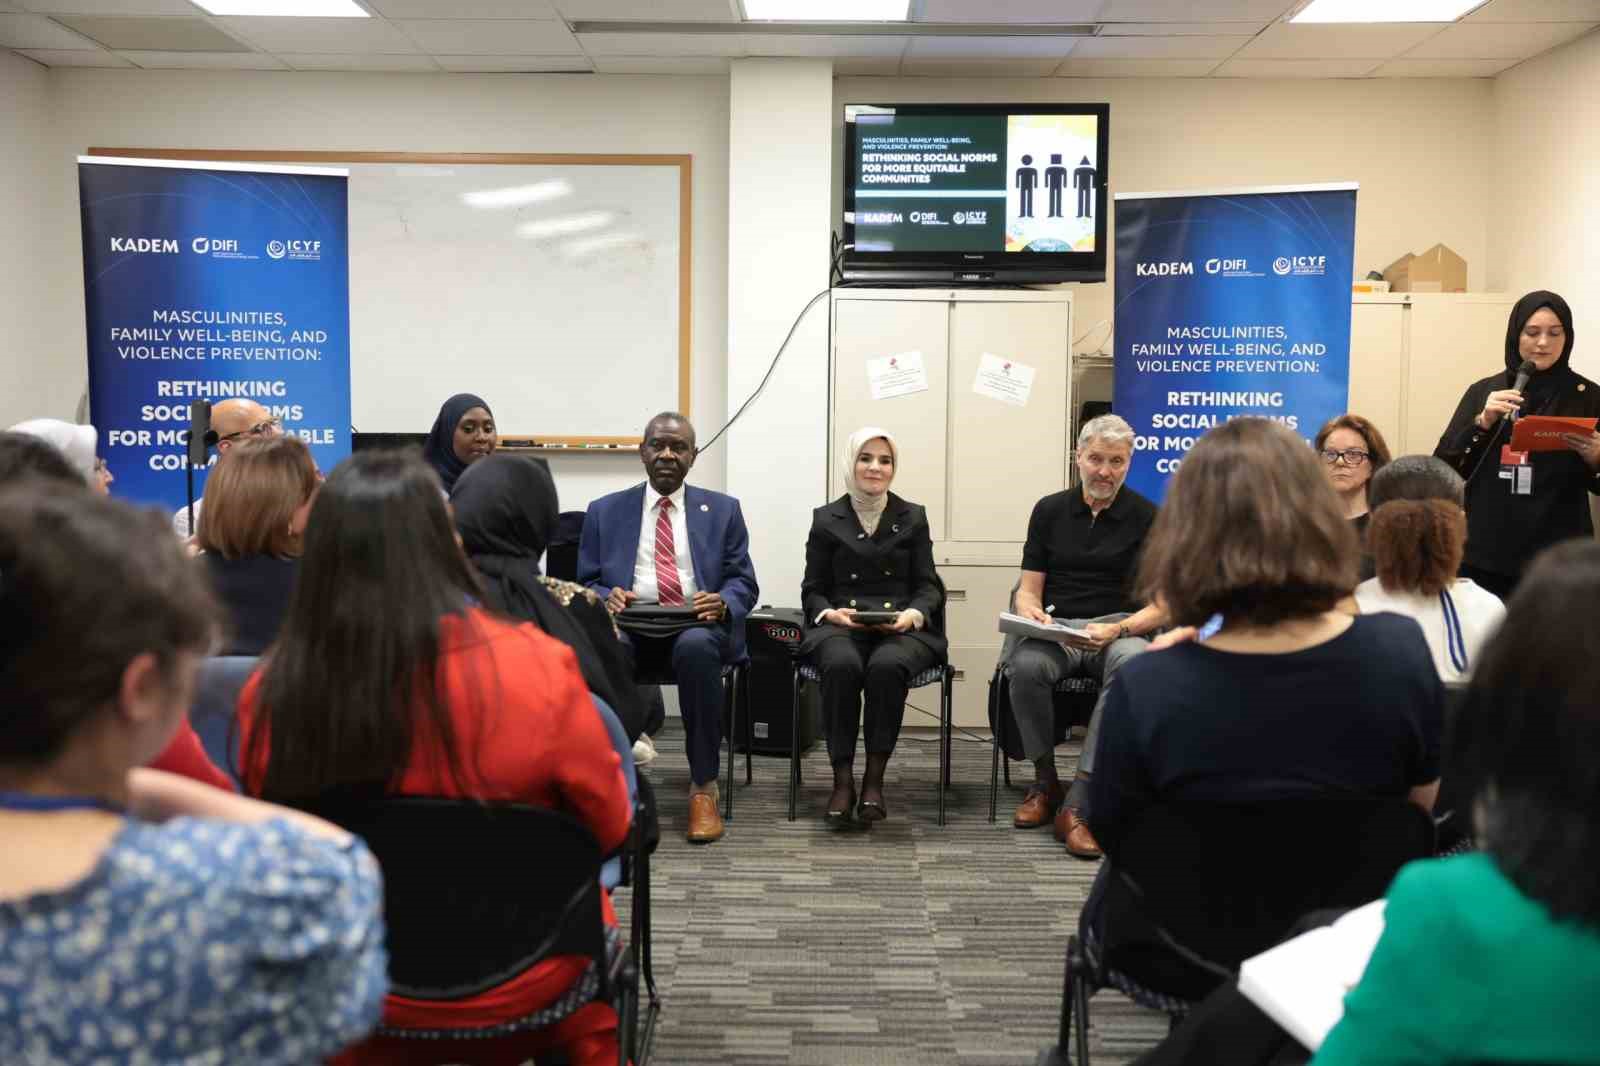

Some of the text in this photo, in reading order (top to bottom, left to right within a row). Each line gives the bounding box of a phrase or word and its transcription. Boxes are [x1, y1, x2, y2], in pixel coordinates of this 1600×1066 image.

[862, 153, 998, 162] RETHINKING SOCIAL NORMS
[862, 164, 966, 174] FOR MORE EQUITABLE
[862, 174, 930, 183] COMMUNITIES
[111, 238, 179, 253] KADEM
[212, 240, 238, 251] DIFI
[287, 240, 320, 251] ICYF
[1222, 259, 1247, 270] DIFI
[1293, 256, 1326, 266] ICYF
[1136, 262, 1194, 276] KADEM
[153, 310, 287, 326] MASCULINITIES,
[111, 328, 327, 344] FAMILY WELL-BEING, AND
[1167, 326, 1288, 340] MASCULINITIES,
[118, 346, 322, 360] VIOLENCE PREVENTION:
[1131, 343, 1326, 357] FAMILY WELL-BEING, AND
[1137, 360, 1320, 373] VIOLENCE PREVENTION:
[157, 381, 286, 397] RETHINKING
[1167, 391, 1283, 407] RETHINKING
[141, 404, 192, 421] SOCI
[108, 430, 188, 446] FOR MO
[1133, 435, 1200, 451] OR MO
